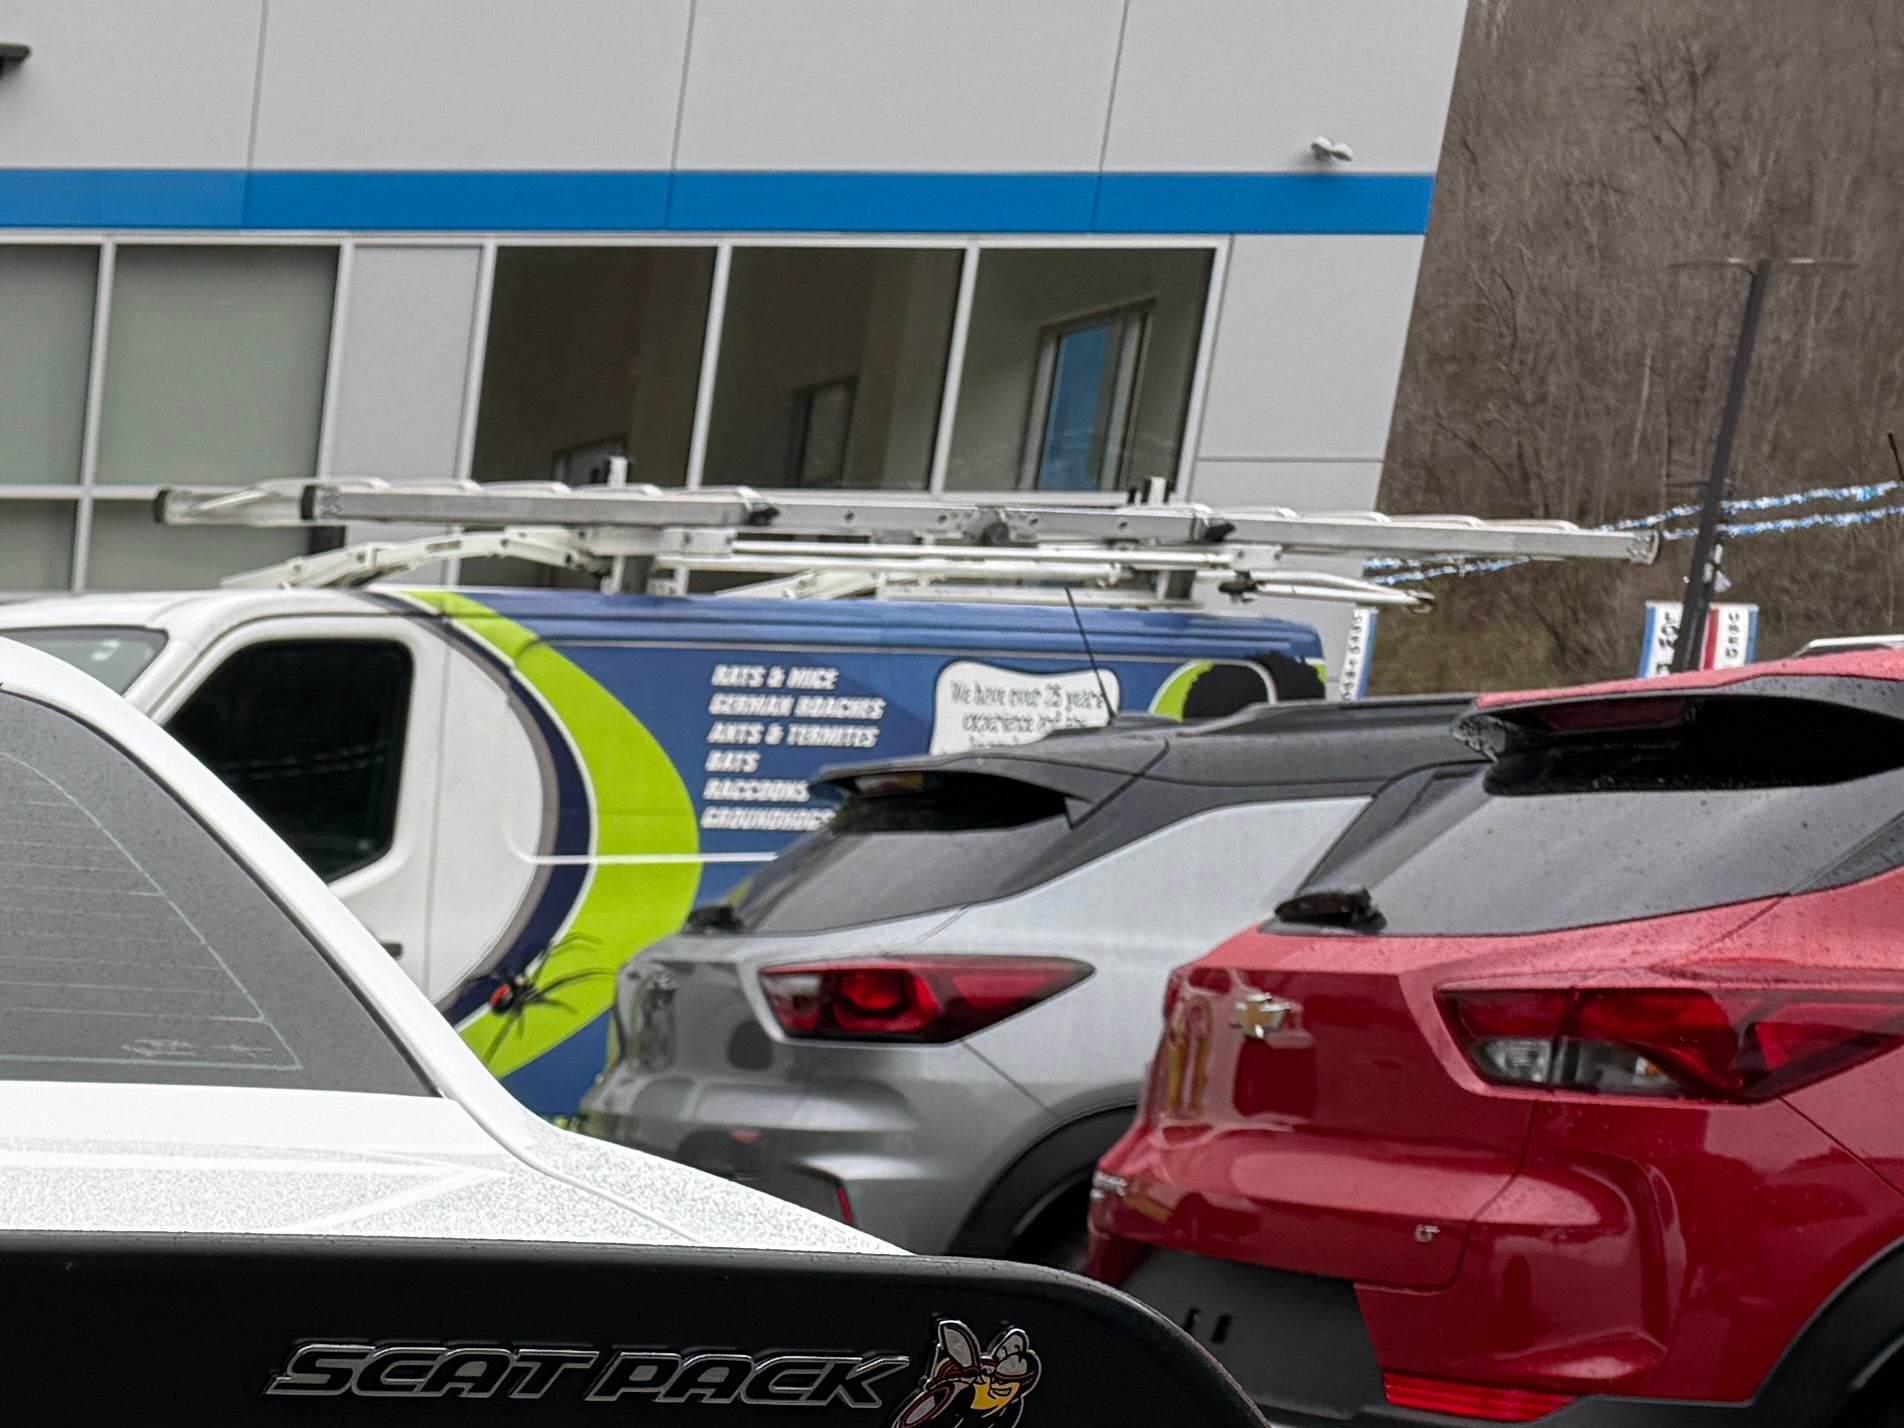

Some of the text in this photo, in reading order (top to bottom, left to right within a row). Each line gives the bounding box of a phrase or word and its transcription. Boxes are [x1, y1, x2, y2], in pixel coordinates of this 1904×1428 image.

[786, 667, 839, 690] MICE
[709, 692, 887, 719] GERMAN ROACHES
[786, 723, 881, 748] TERMITES
[266, 1341, 912, 1409] SCAT PACK
